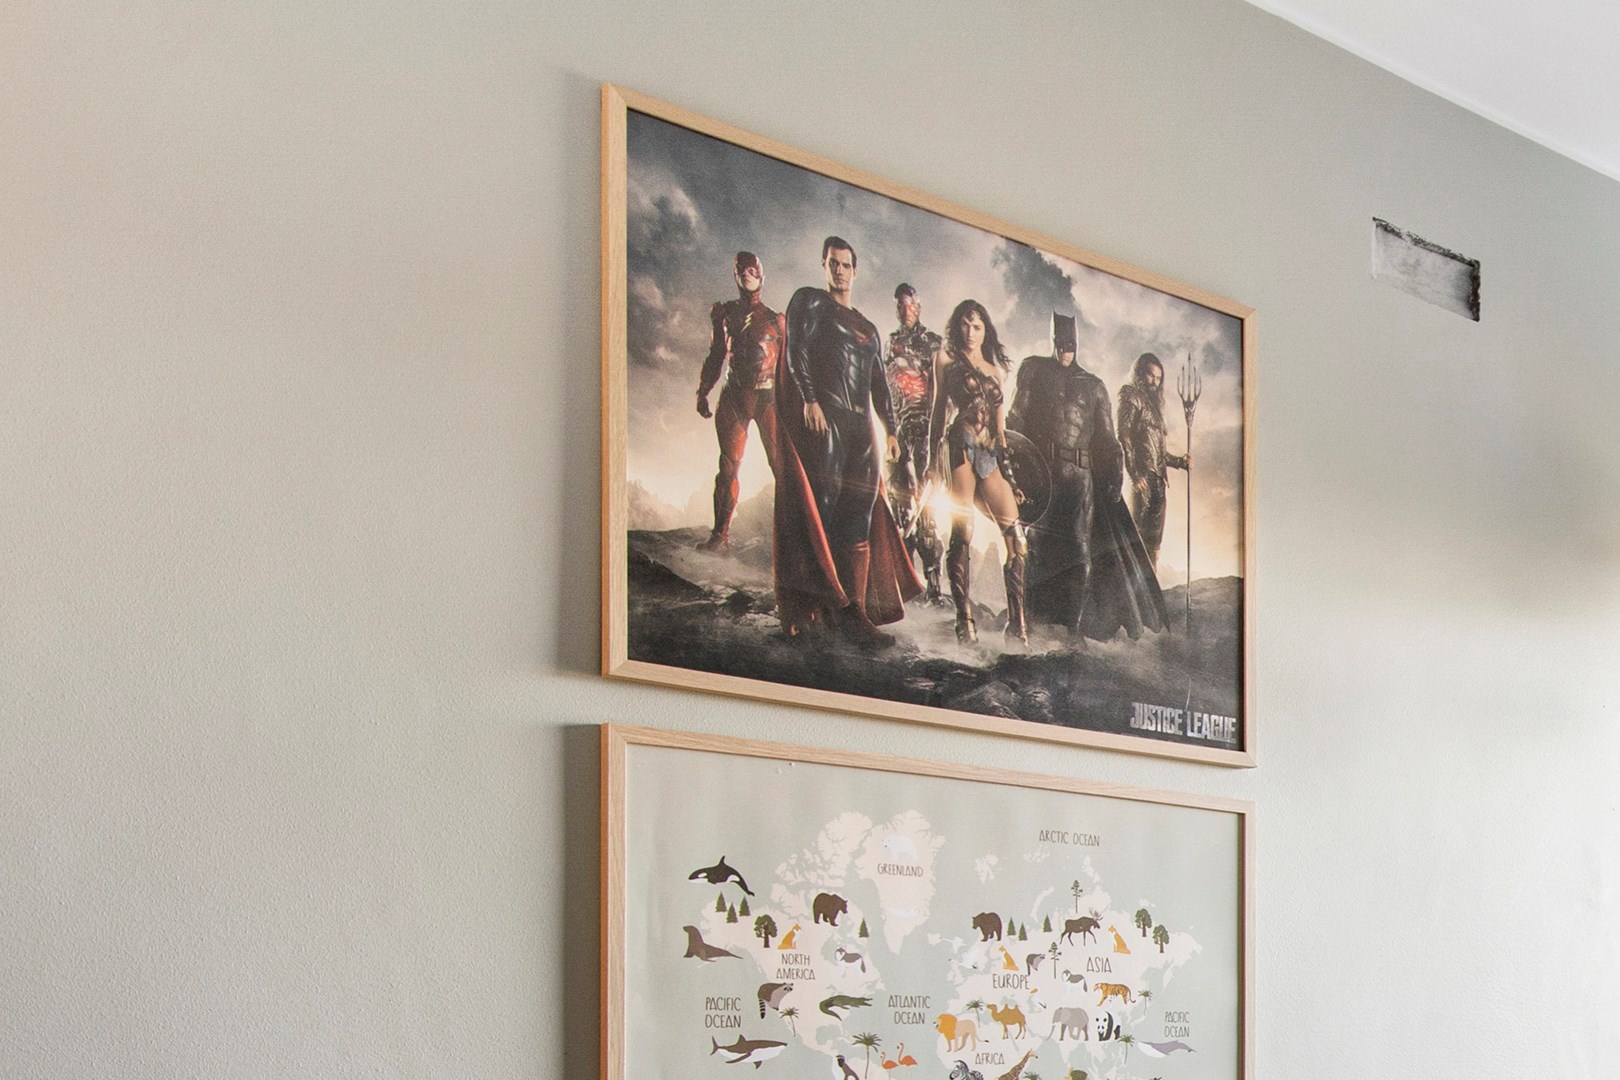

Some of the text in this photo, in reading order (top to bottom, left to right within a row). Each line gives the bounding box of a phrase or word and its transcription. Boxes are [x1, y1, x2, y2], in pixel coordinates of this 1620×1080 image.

[1130, 701, 1237, 744] JUSTICE LEAGUE
[1039, 829, 1100, 847] ARCTIC OCEAN
[877, 863, 924, 877] GREENLAND
[781, 953, 811, 965] NORTH
[1086, 956, 1112, 973] ASIA
[776, 967, 816, 980] AMERICA
[992, 973, 1030, 989] EUROPE
[705, 996, 742, 1011] PACIFIC
[888, 994, 931, 1009] ATLANTIC
[704, 1013, 742, 1029] OCEAN
[894, 1011, 926, 1025] OCEAN
[1164, 1011, 1190, 1023] PACIFIC
[1164, 1025, 1190, 1038] OCEAN
[975, 1052, 1005, 1065] AFRICA
